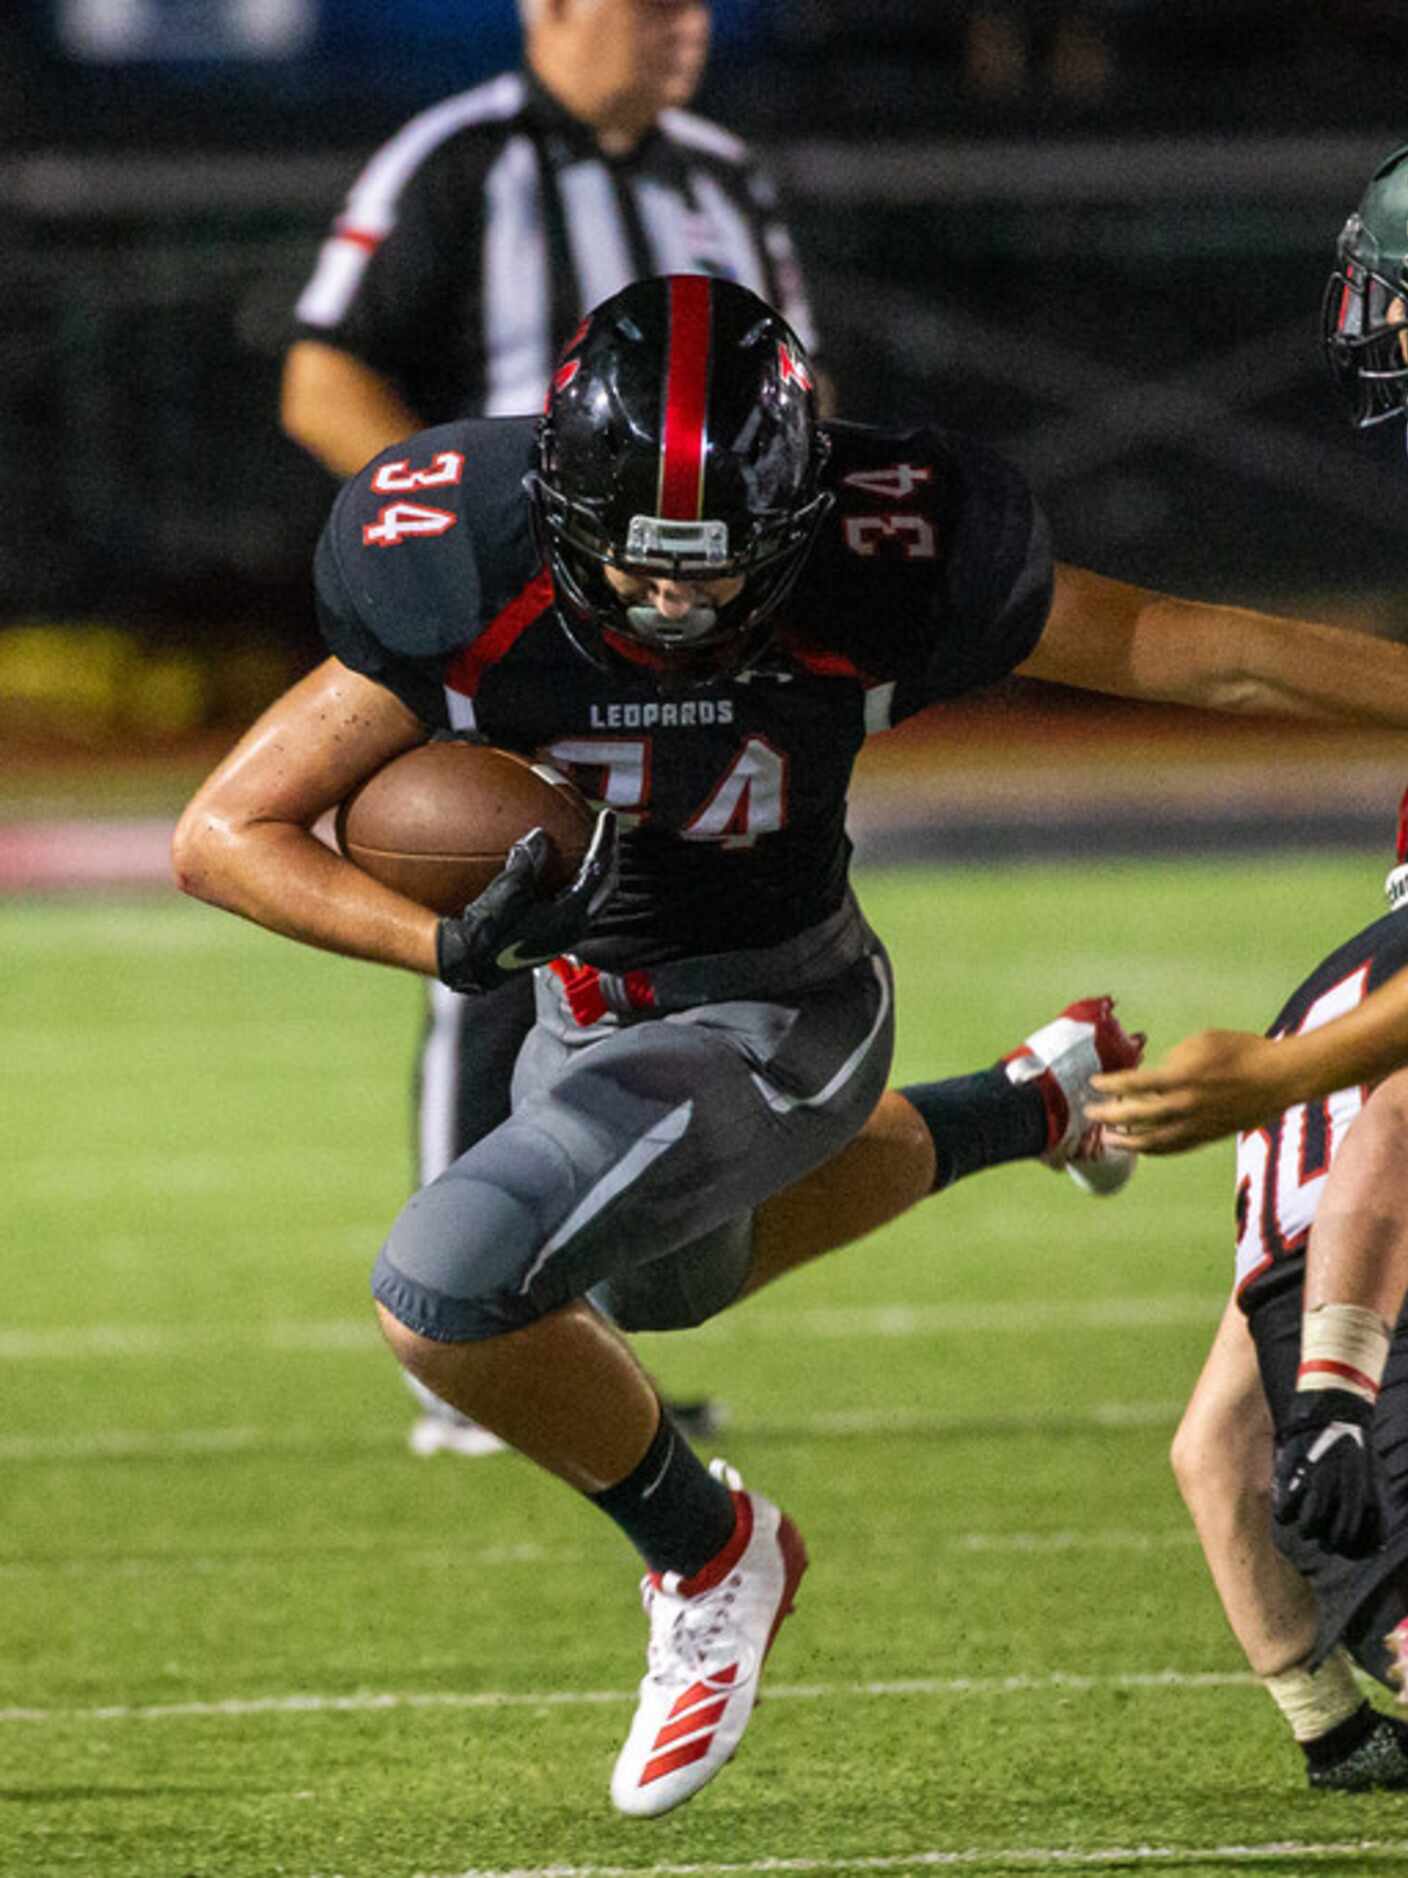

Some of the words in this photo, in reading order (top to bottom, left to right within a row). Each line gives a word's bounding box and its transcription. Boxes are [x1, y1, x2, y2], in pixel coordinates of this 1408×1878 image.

[362, 448, 465, 548] 34
[841, 463, 936, 558] 34
[590, 699, 733, 729] LEOPARDS
